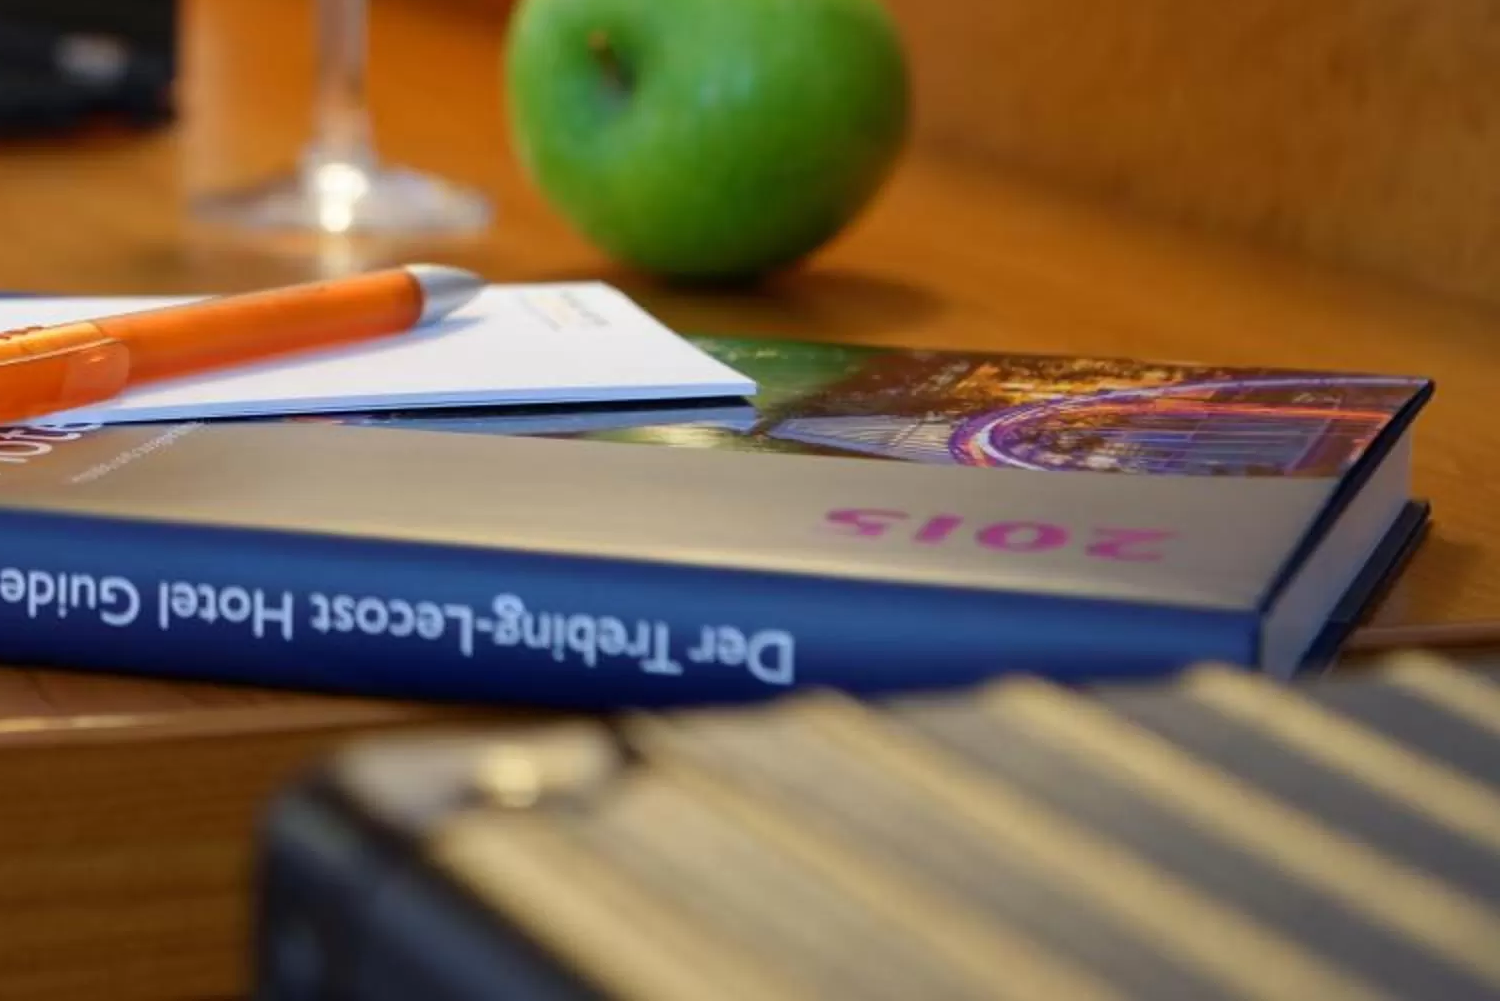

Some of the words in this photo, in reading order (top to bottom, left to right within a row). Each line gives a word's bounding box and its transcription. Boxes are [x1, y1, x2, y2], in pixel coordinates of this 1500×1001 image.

[823, 508, 1182, 563] 2015
[0, 567, 140, 626] Guide
[158, 579, 294, 641] Hotel
[310, 592, 684, 676] Trebing-Lecost
[687, 624, 795, 685] Der
